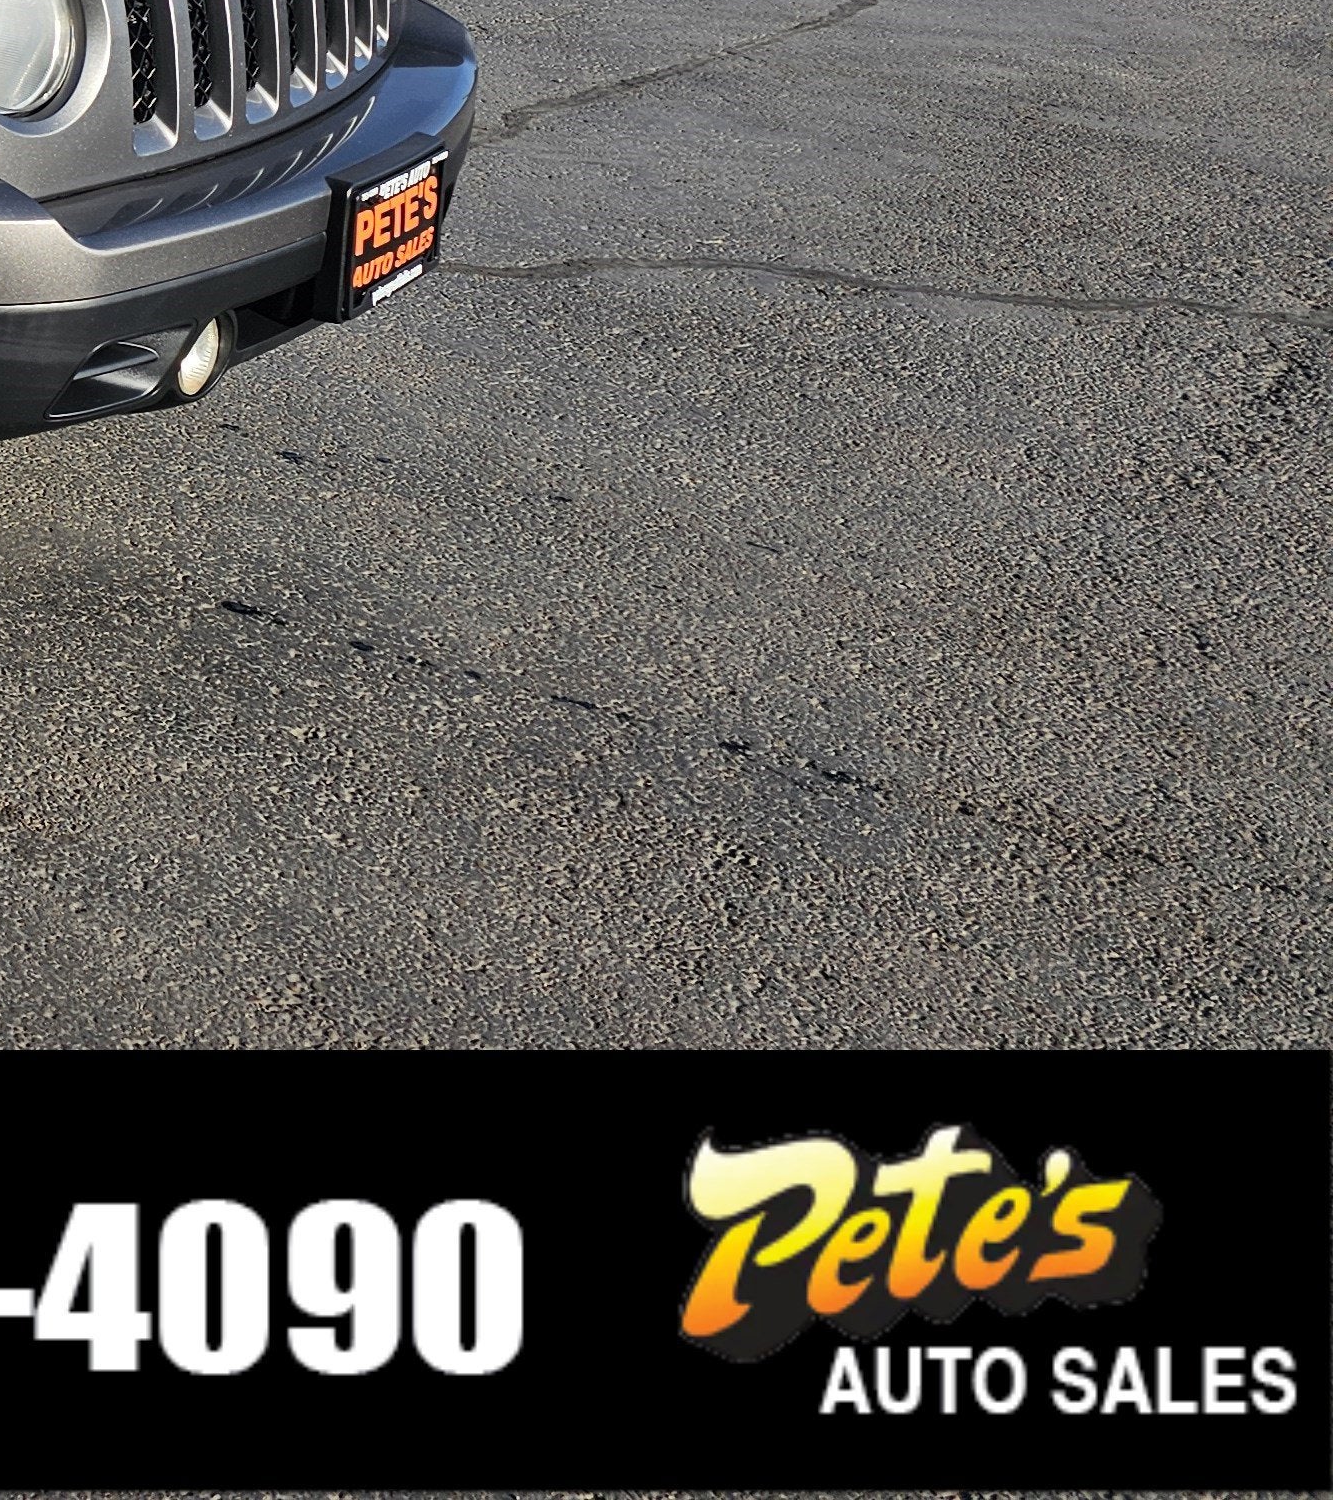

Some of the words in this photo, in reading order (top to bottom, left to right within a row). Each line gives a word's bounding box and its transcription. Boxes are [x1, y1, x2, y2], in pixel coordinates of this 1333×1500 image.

[354, 175, 438, 257] PETE'S
[352, 251, 394, 289] AUTO
[394, 225, 435, 268] SALES
